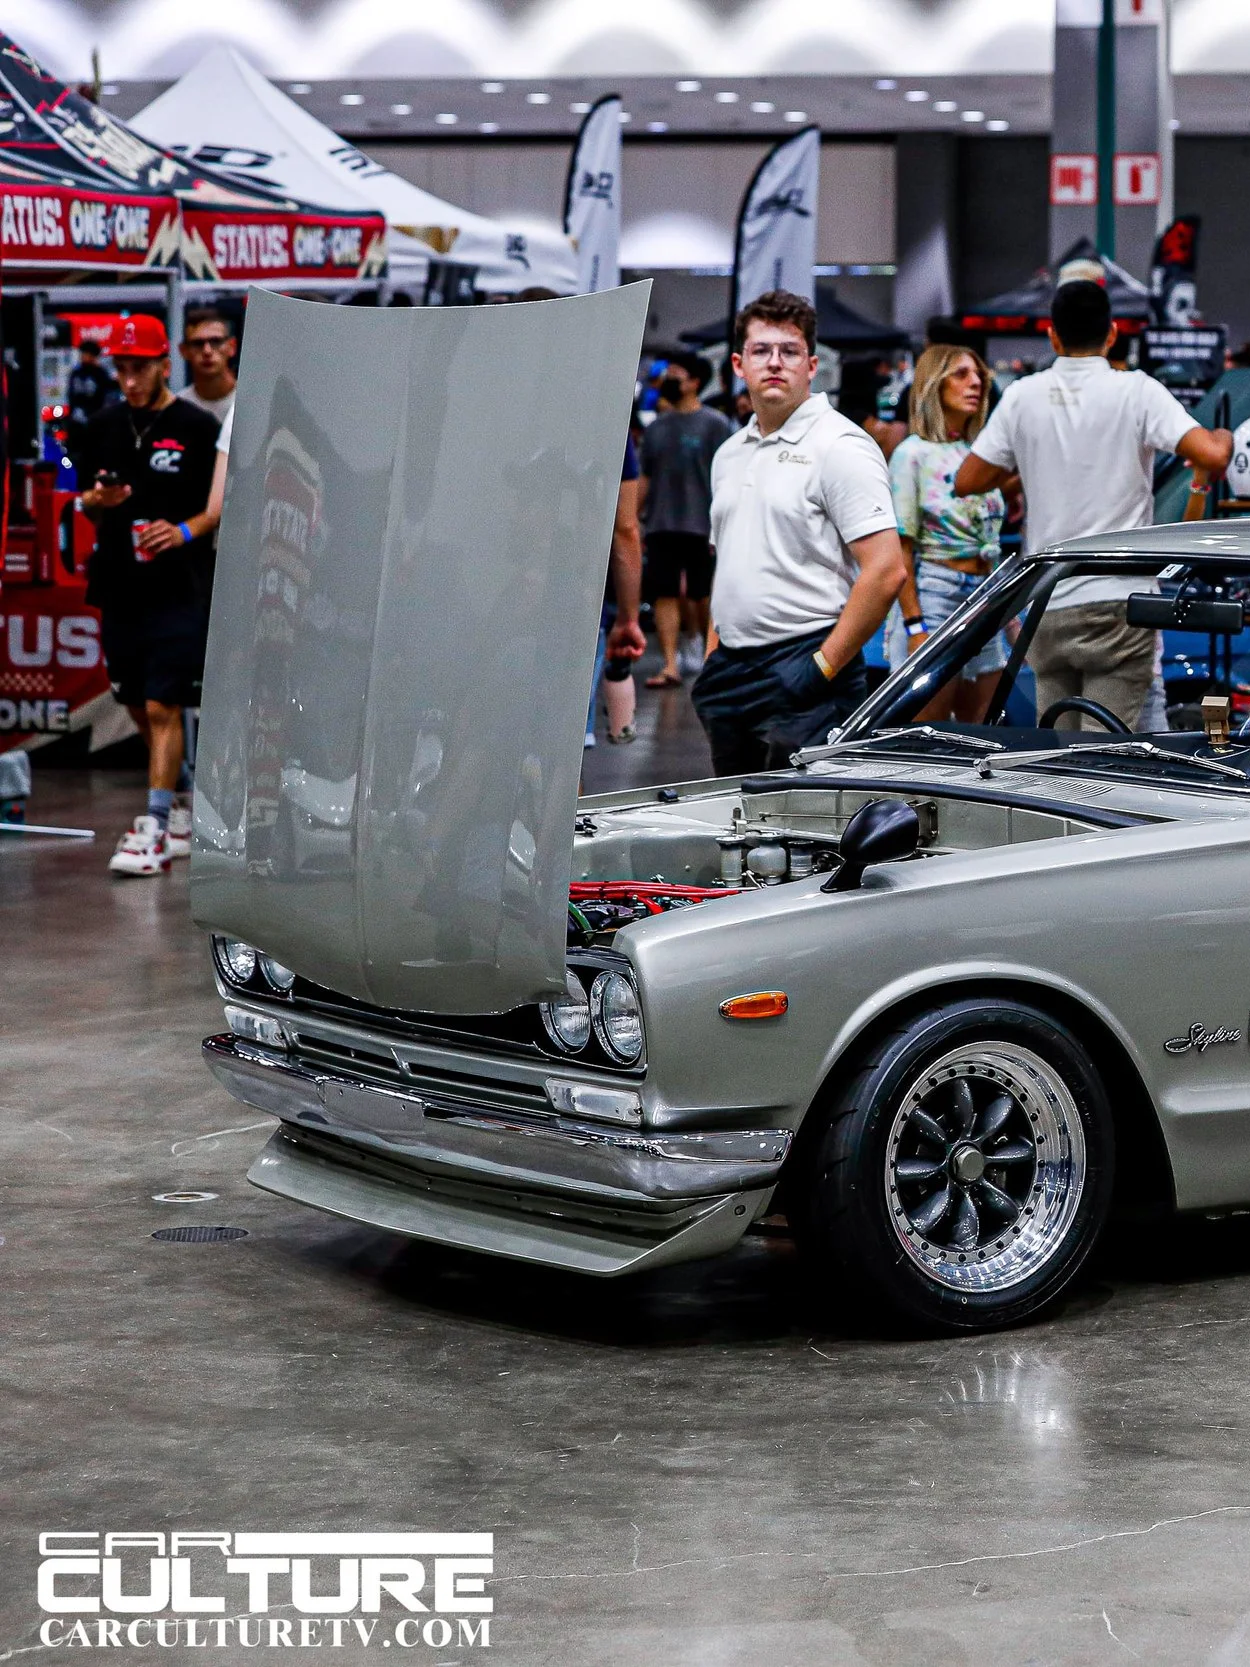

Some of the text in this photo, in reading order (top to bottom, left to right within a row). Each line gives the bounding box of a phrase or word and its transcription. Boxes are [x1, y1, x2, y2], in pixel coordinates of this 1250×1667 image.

[69, 199, 106, 245] ONE
[115, 204, 150, 249] ONE
[0, 614, 100, 668] US
[0, 699, 69, 730] ONE
[1164, 1022, 1242, 1053] Skyline
